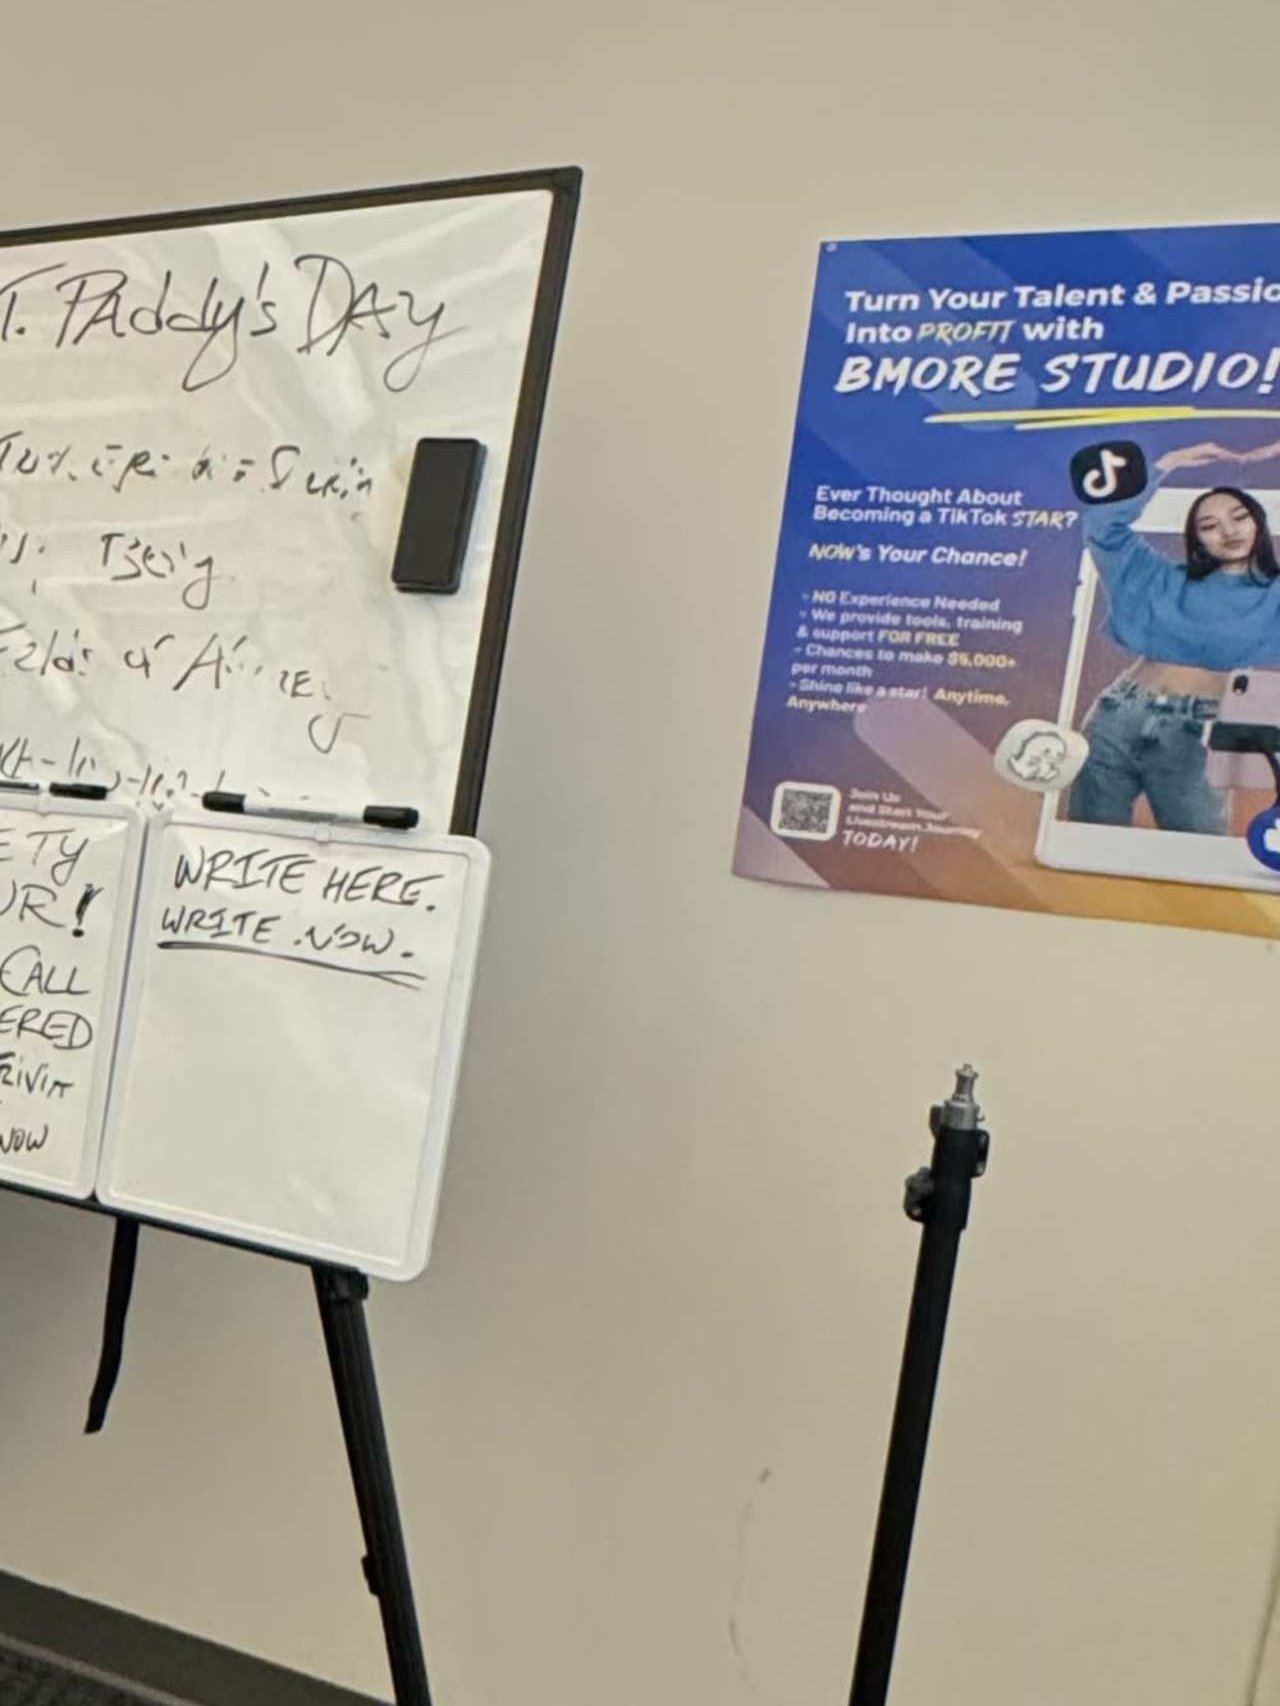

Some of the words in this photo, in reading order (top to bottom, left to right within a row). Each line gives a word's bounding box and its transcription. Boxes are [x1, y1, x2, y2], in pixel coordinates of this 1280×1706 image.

[845, 290, 920, 312] Turn
[928, 287, 1007, 310] Your
[1013, 283, 1125, 308] Talent
[1132, 281, 1157, 305] &
[845, 322, 913, 345] Into
[915, 319, 1017, 347] PROFIT
[1022, 316, 1105, 342] with
[833, 352, 1022, 398] BMORE
[1040, 347, 1280, 395] STUDIO!
[815, 485, 862, 503] Ever
[866, 486, 953, 508] Thought
[956, 488, 1024, 506] About
[812, 504, 915, 526] Becoming
[918, 509, 932, 524] a
[937, 507, 1008, 527] TikTok
[1011, 510, 1079, 530] STAR?
[808, 543, 872, 562] NOW's
[877, 544, 926, 564] Your
[930, 546, 1030, 568] Chance!
[811, 590, 837, 603] NO
[839, 591, 932, 609] Experience
[933, 594, 1001, 612] Needed
[810, 608, 836, 622] We
[839, 610, 902, 627] provide
[956, 615, 1024, 635] training
[796, 624, 809, 639] &
[812, 627, 874, 645] support
[878, 629, 912, 644] FOR
[915, 631, 961, 647] FREE
[805, 642, 875, 661] Chances
[877, 646, 895, 661] to
[898, 647, 945, 665] make
[791, 662, 819, 678] per
[820, 662, 873, 678] month
[798, 677, 844, 695] Shine
[846, 679, 874, 696] like
[841, 829, 921, 854] TODAY!
[174, 845, 316, 895] WRITE
[321, 864, 446, 914] HERE.
[161, 905, 281, 946] WRITE
